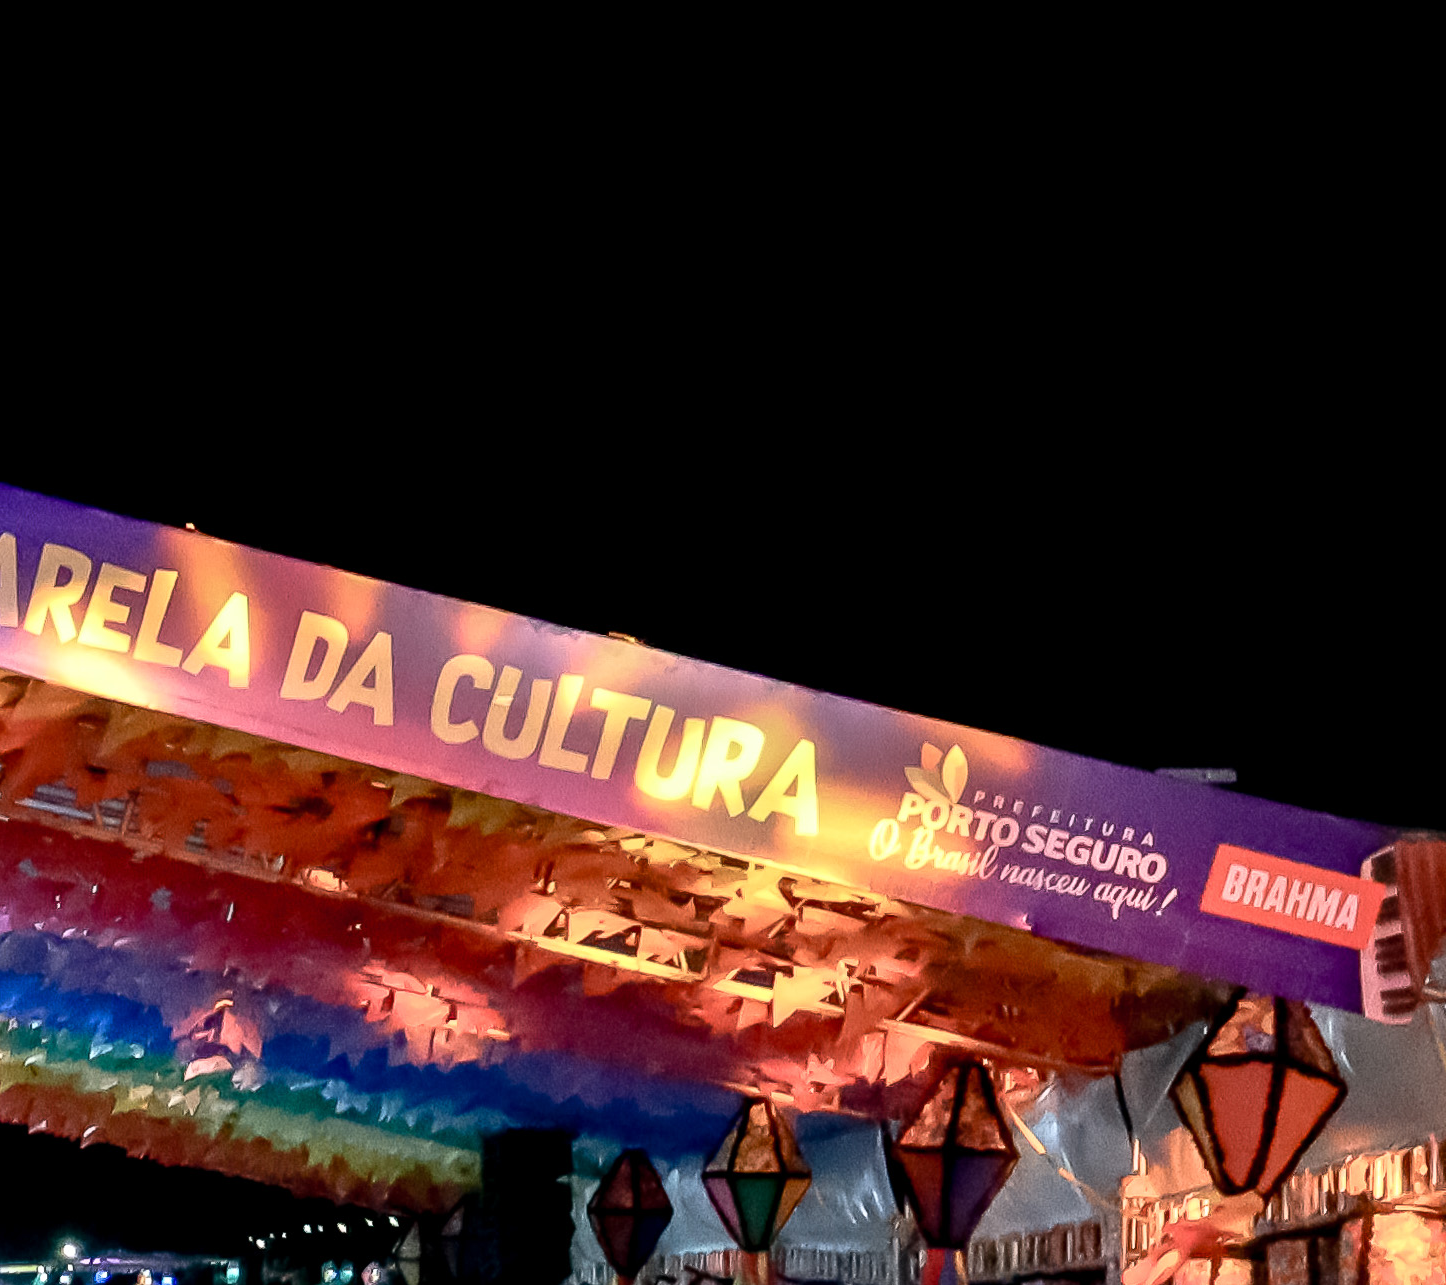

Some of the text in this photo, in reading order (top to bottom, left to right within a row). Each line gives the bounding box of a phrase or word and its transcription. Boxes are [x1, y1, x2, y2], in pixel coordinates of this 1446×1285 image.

[278, 610, 394, 726] DA
[430, 652, 820, 837] CULTURA
[868, 818, 902, 862] O
[903, 827, 999, 881] Brasil
[999, 862, 1091, 899] nasceu
[896, 791, 1168, 885] PORTO SEGURO
[973, 789, 1156, 848] PREFEITURA
[1222, 863, 1359, 933] BRAHMA
